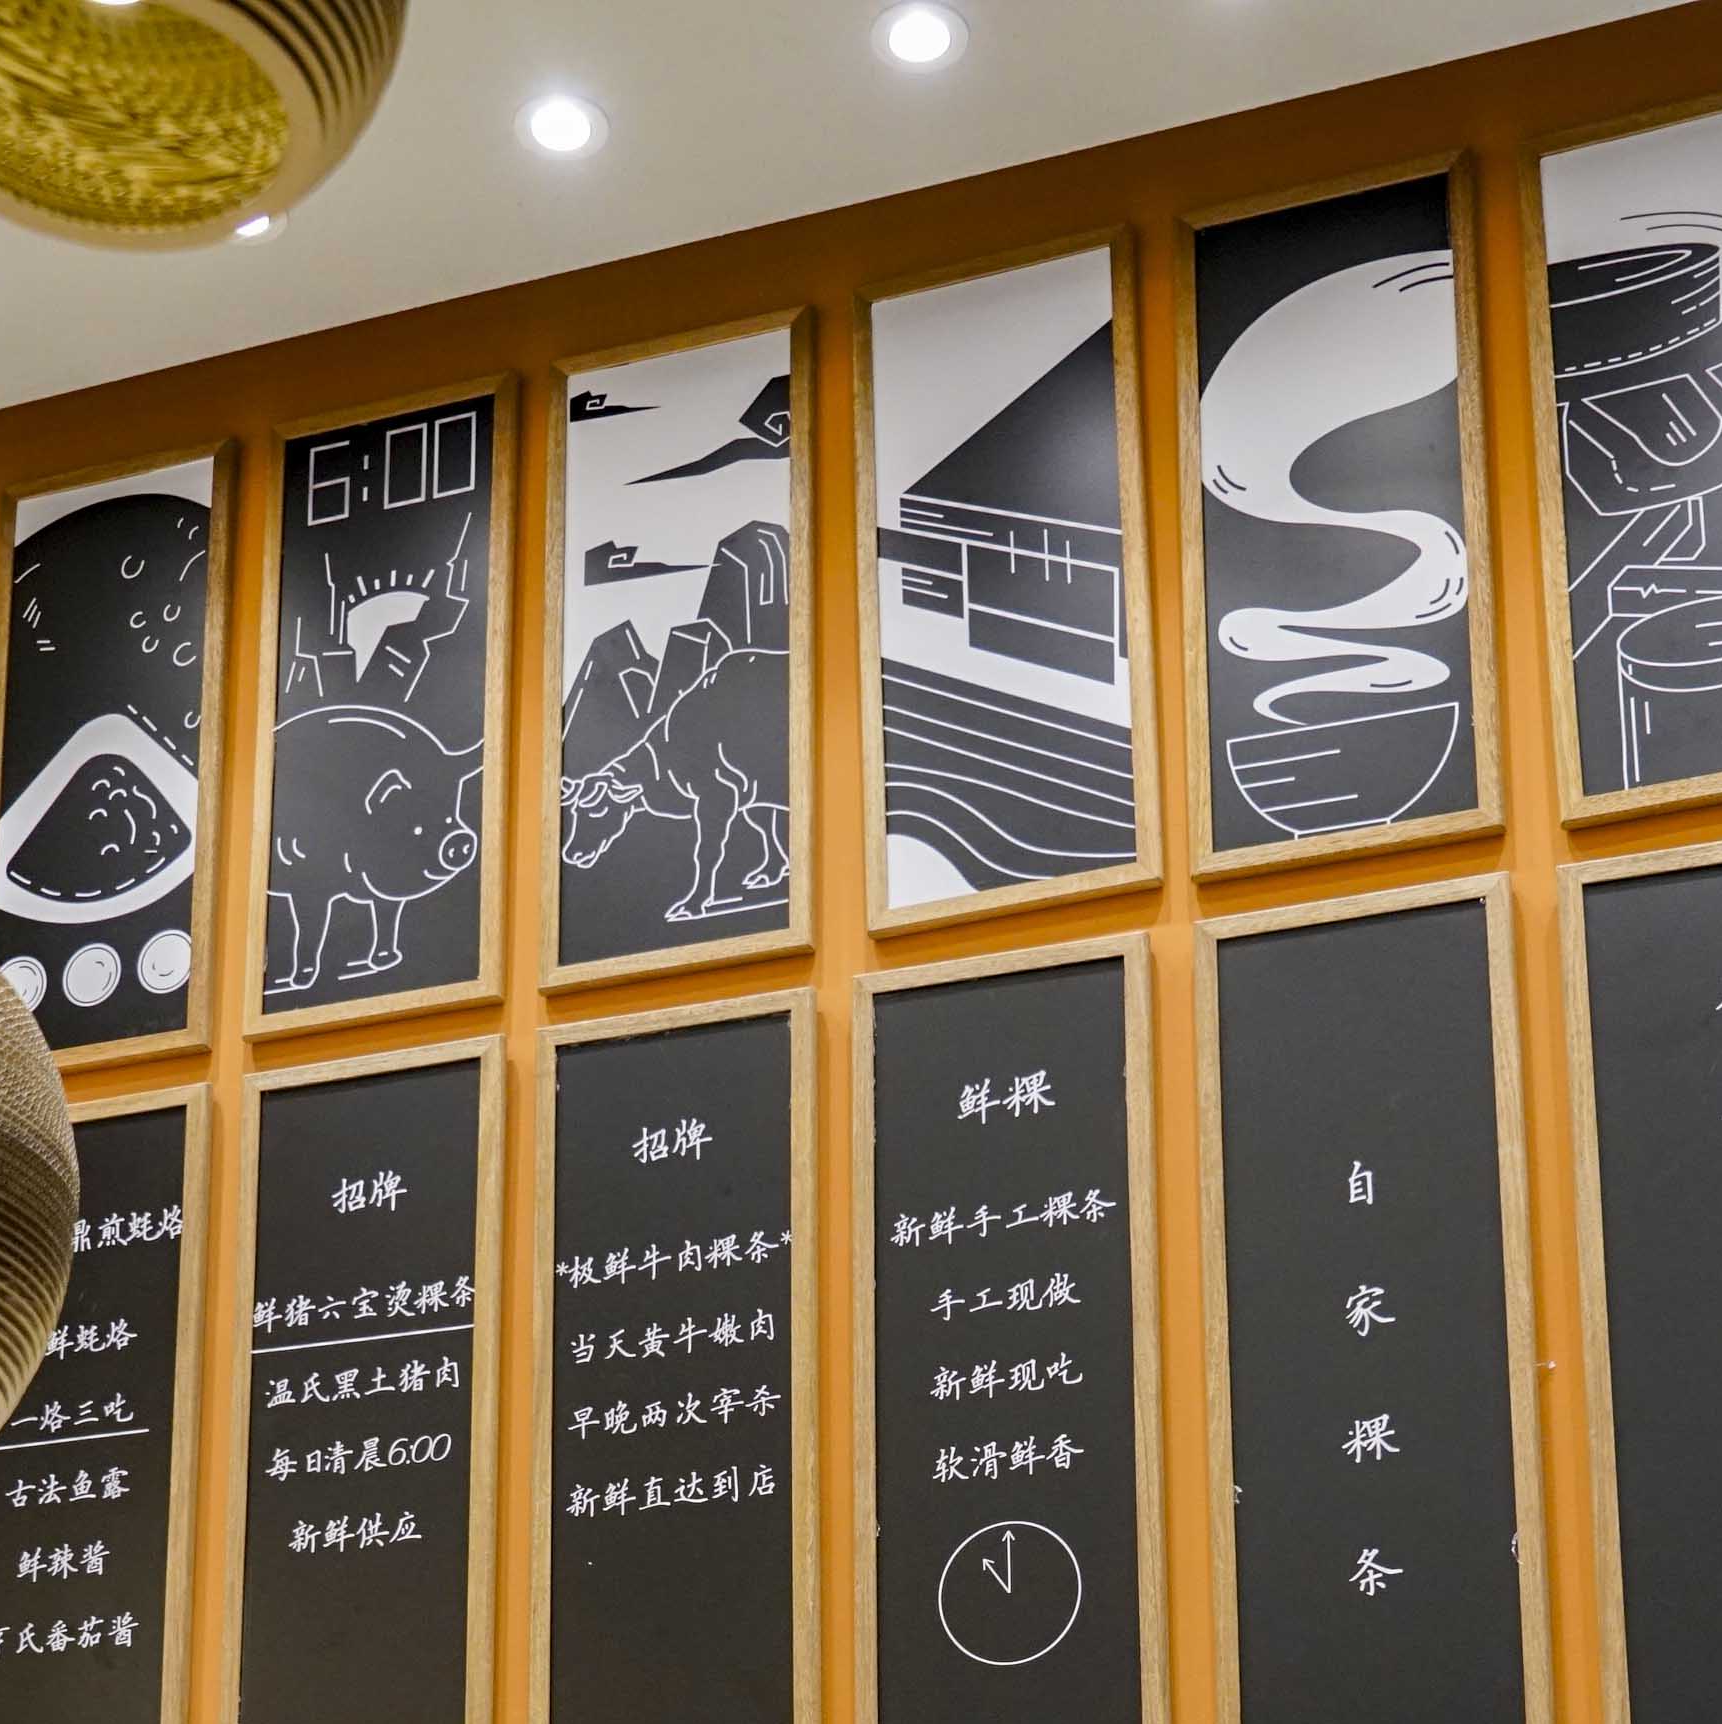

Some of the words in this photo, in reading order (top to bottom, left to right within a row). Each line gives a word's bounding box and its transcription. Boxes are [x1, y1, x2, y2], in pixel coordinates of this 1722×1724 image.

[307, 410, 477, 527] 6:00
[957, 1069, 1056, 1125] 鲜粿
[632, 1117, 713, 1164] 招牌
[331, 1170, 408, 1214] 招牌
[890, 1188, 1117, 1247] 新鲜手工粿条
[252, 1275, 475, 1332] 鲜猪六宝烫粿条
[930, 1272, 1081, 1321] 手工现做
[570, 1308, 775, 1364] 当天黄牛嫩肉
[265, 1356, 460, 1409] 温氏黑土猪肉
[930, 1351, 1083, 1401] 新鲜现吃
[1341, 1160, 1404, 1596] 自家粿条
[10, 1393, 134, 1432] 一烙三吃
[567, 1384, 782, 1440] 早晚两次宰杀
[265, 1433, 452, 1482] 每日清晨6:00
[932, 1433, 1085, 1483] 软滑鲜香
[5, 1466, 130, 1508] 古法鱼露
[565, 1464, 776, 1518] 新鲜直达到店
[288, 1511, 422, 1554] 新鲜供应
[16, 1539, 110, 1583] 鲜辣酱
